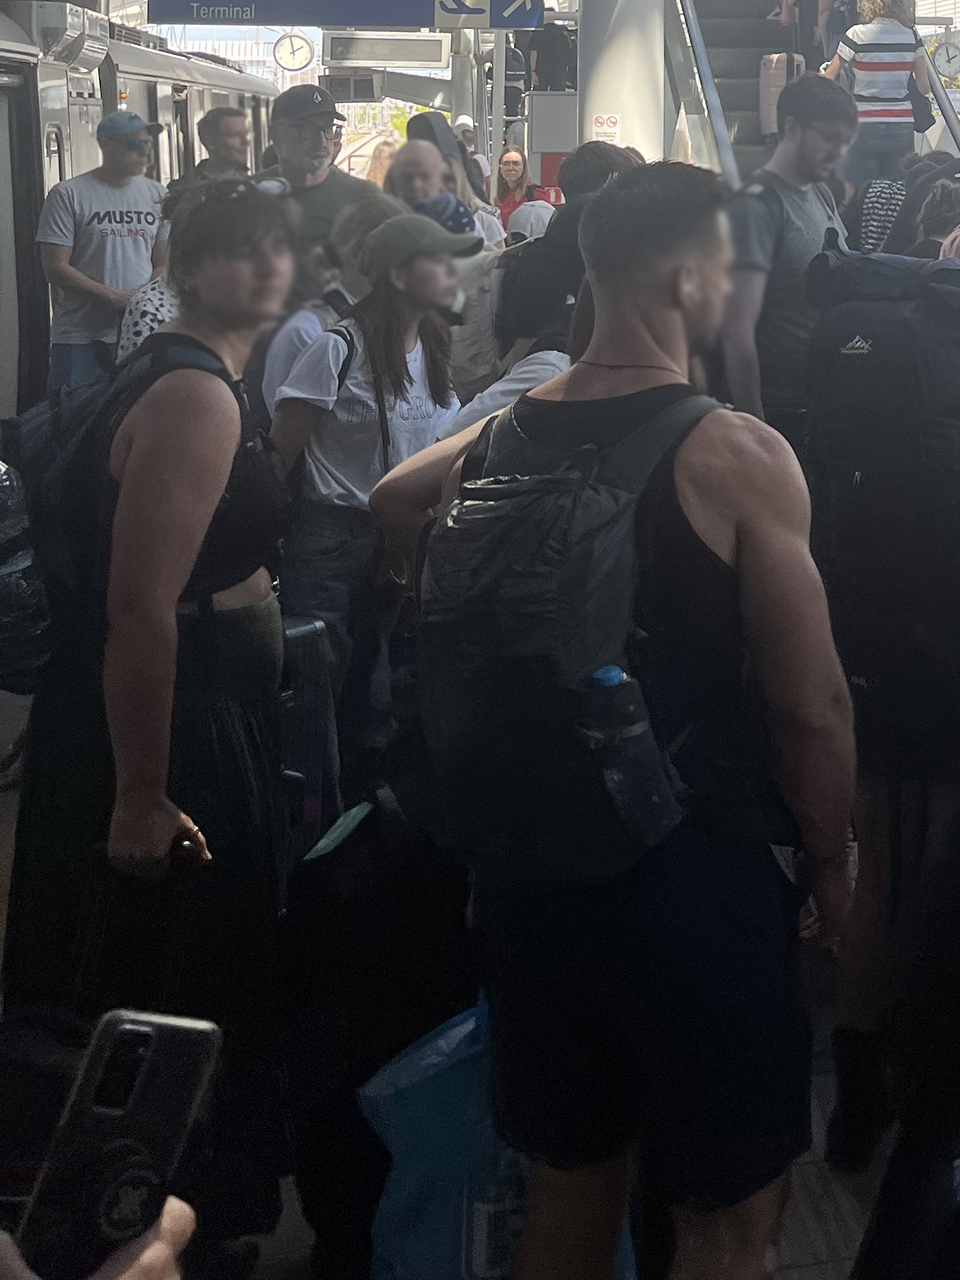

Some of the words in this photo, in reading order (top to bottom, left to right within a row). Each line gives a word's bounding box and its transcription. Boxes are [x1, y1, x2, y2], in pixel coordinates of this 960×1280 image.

[190, 3, 255, 19] Terminal
[86, 210, 156, 226] MUSTO
[100, 228, 145, 238] SAILING
